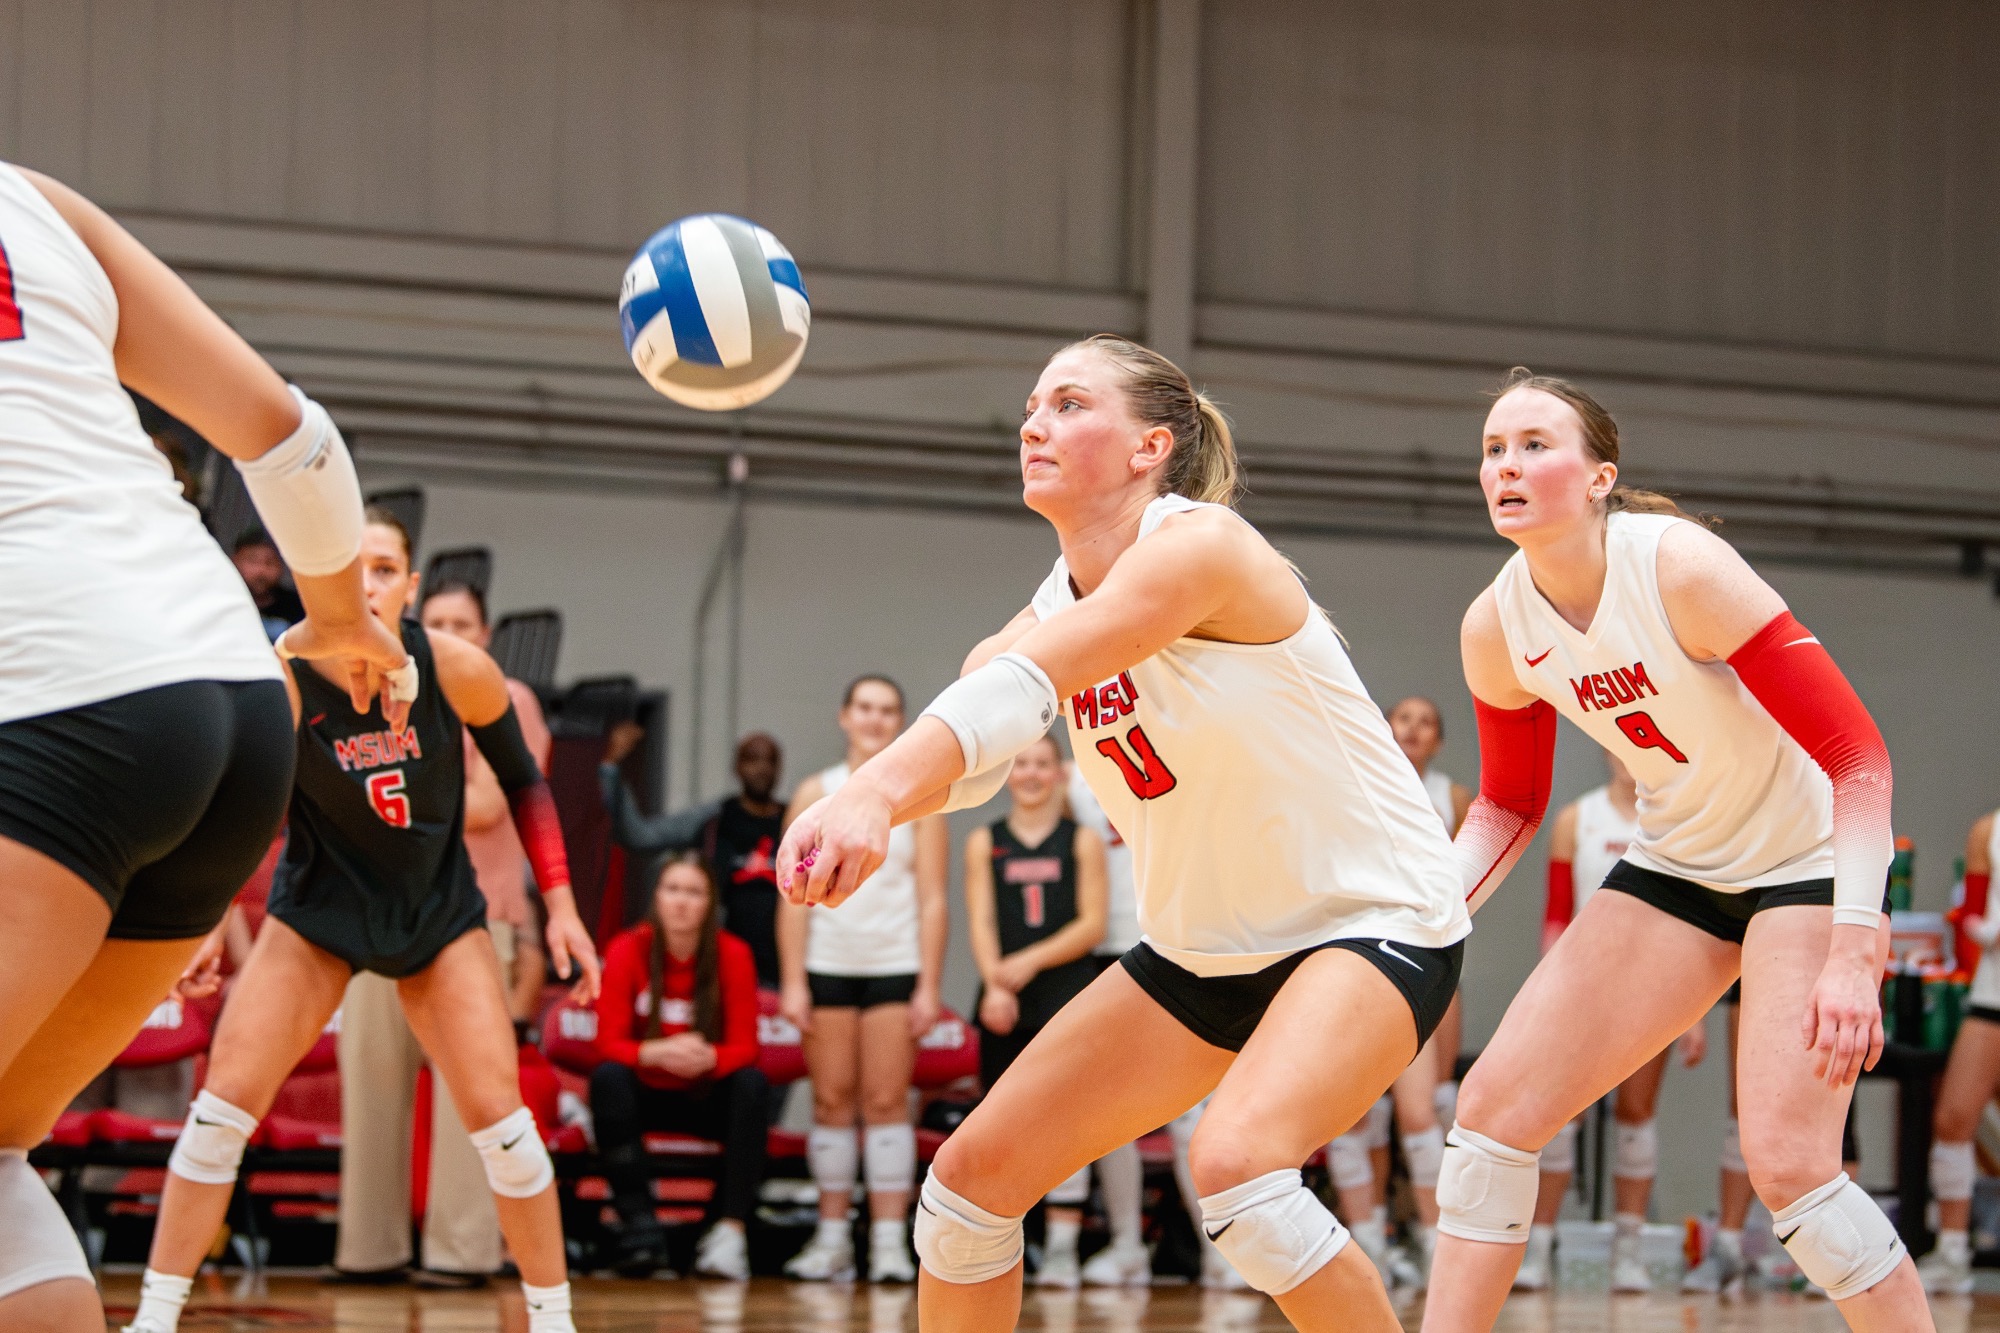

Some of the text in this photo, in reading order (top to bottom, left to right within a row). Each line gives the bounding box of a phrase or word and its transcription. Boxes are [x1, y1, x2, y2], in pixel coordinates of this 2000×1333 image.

[1568, 661, 1660, 713] MSUM
[333, 725, 422, 772] MSUM
[1614, 710, 1690, 764] 9
[365, 767, 412, 829] 6
